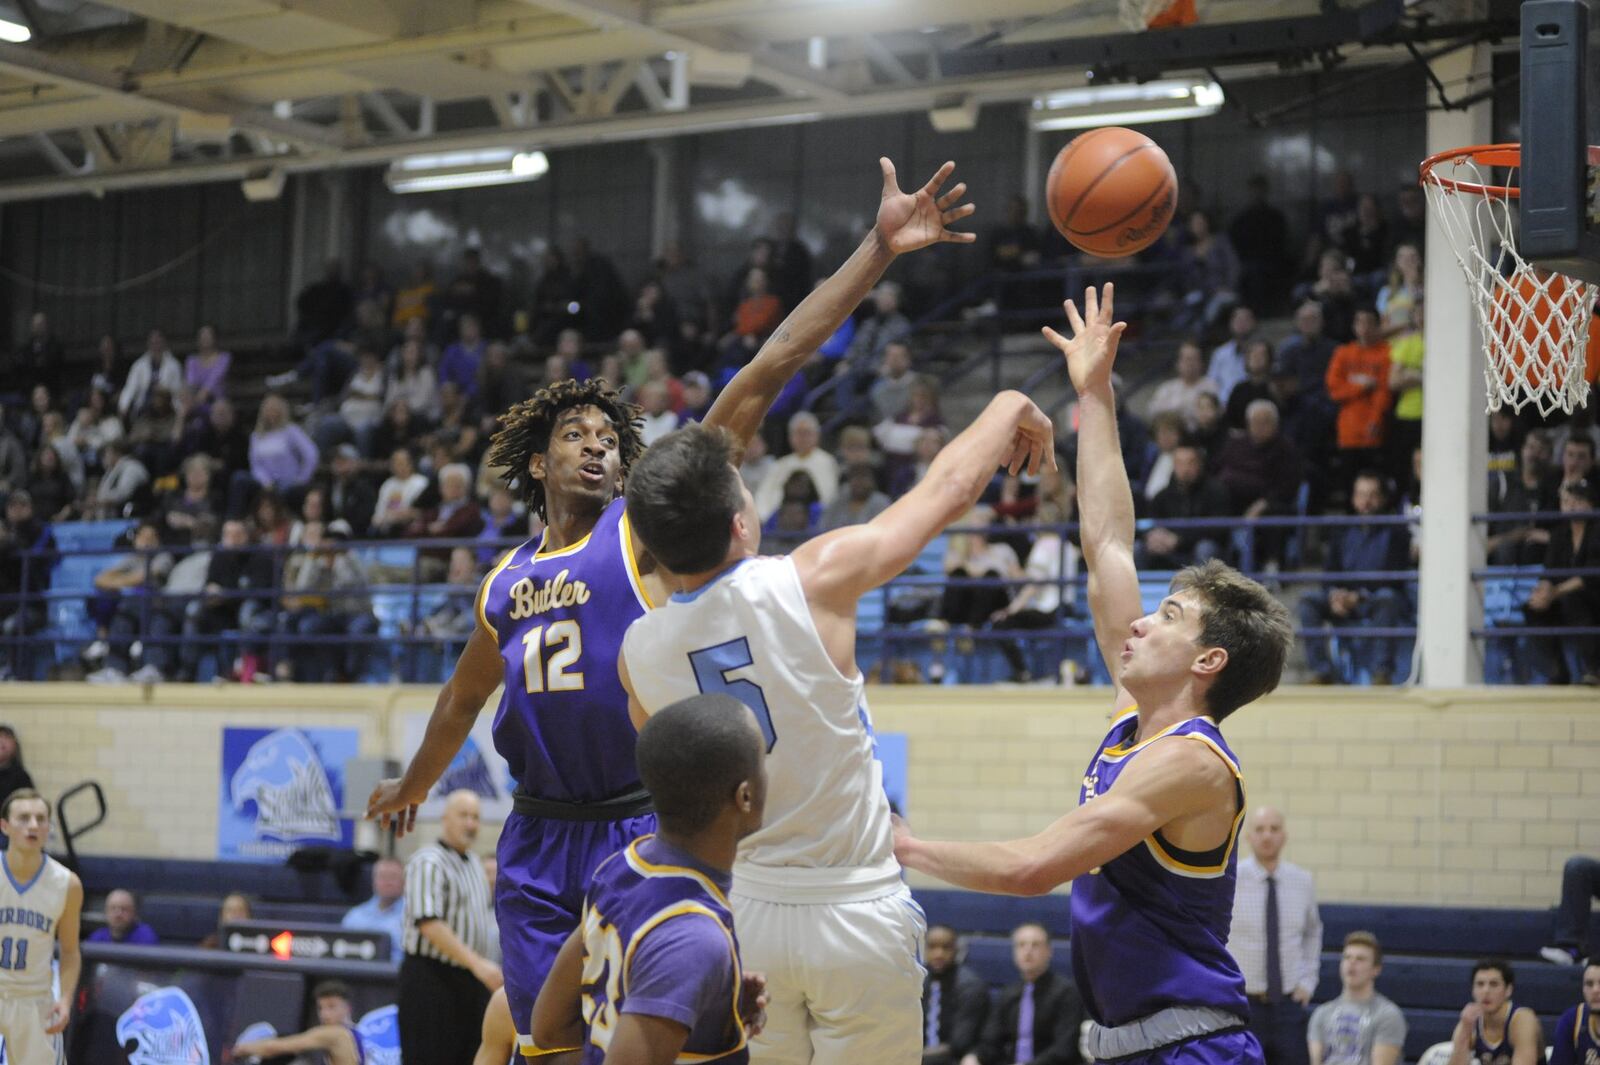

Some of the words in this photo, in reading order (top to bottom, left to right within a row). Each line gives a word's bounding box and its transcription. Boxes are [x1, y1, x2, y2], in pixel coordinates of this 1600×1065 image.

[509, 569, 591, 620] Butler
[522, 619, 585, 694] 12
[687, 635, 777, 754] 5
[0, 936, 28, 971] 11
